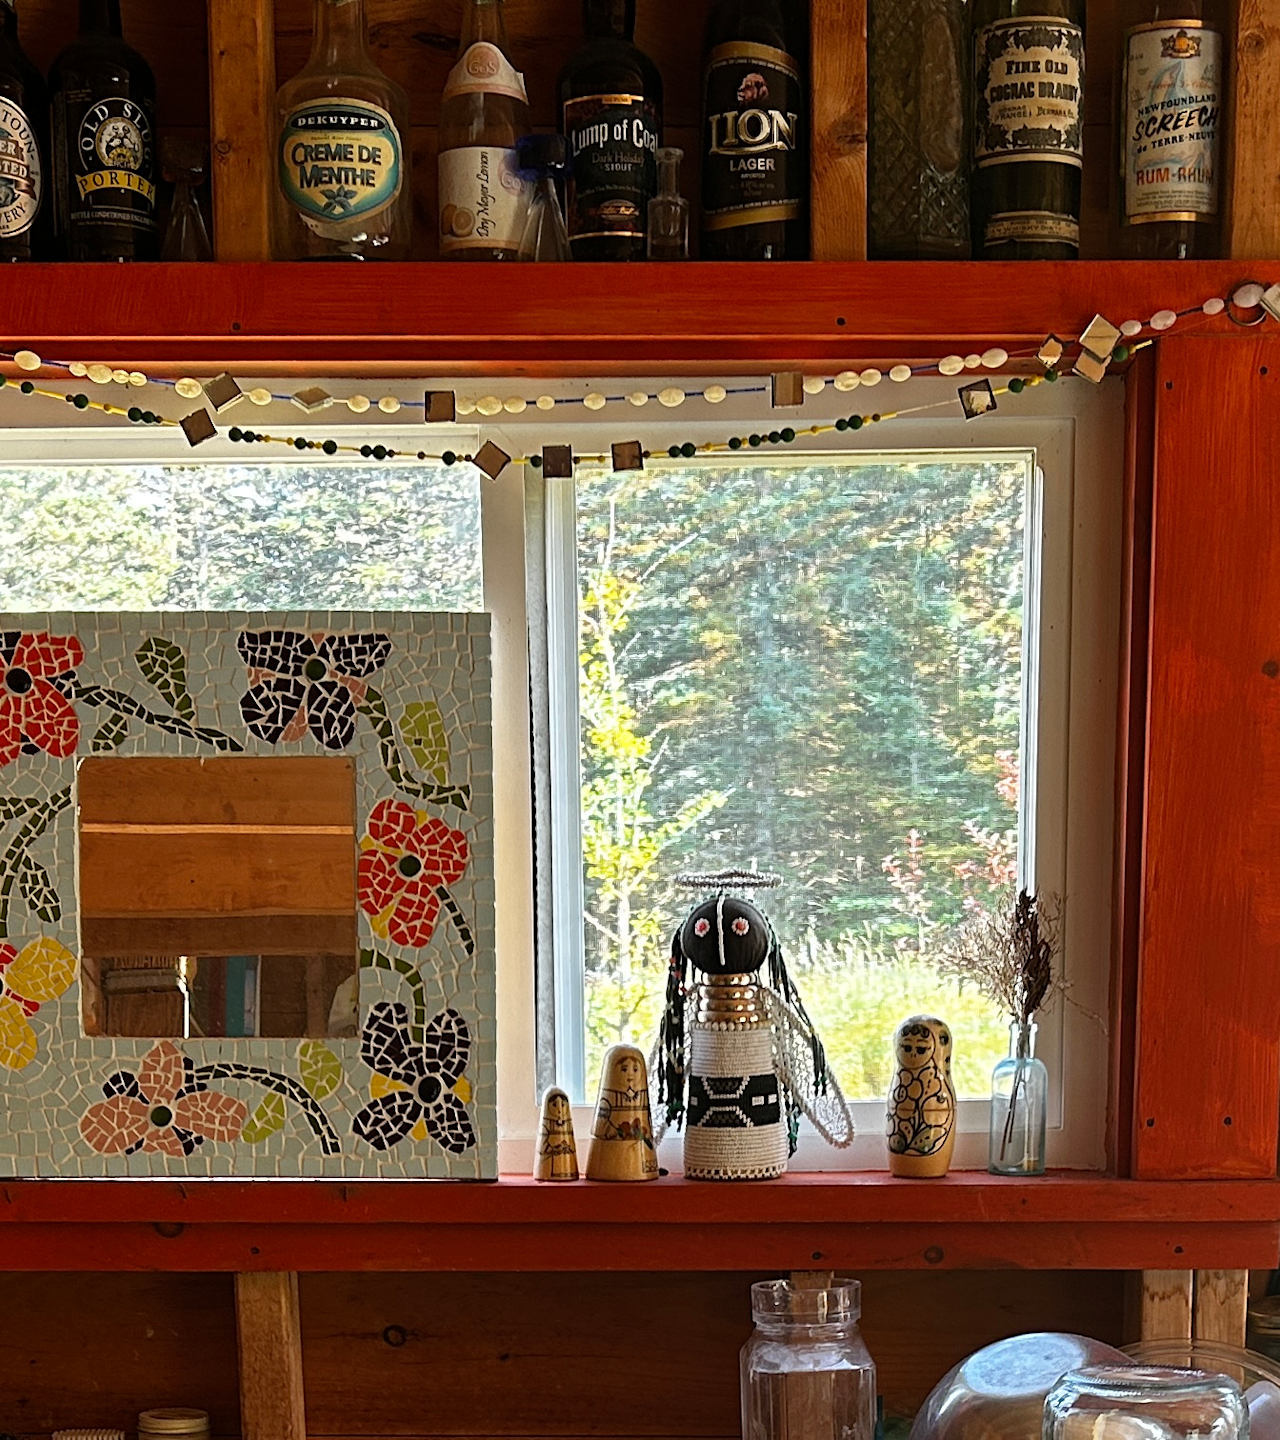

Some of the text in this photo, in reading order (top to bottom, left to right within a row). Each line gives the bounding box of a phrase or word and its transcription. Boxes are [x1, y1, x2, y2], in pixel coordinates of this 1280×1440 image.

[1005, 59, 1068, 76] FINE OLD
[990, 81, 1078, 102] COGNAC BRANDY
[1137, 93, 1216, 116] NEWFOUNDLAND
[81, 104, 109, 151] OLD
[297, 115, 379, 128] DEKUYPER
[708, 108, 798, 156] LION
[1132, 105, 1219, 142] SCREECH
[571, 118, 658, 157] Lump of Coal
[291, 142, 381, 166] CREME DE
[729, 158, 776, 172] LAGER
[299, 164, 376, 189] MENTHE
[604, 163, 633, 172] STOUT
[79, 171, 154, 200] PORTER
[476, 151, 496, 238] Dry Meyer Lemon
